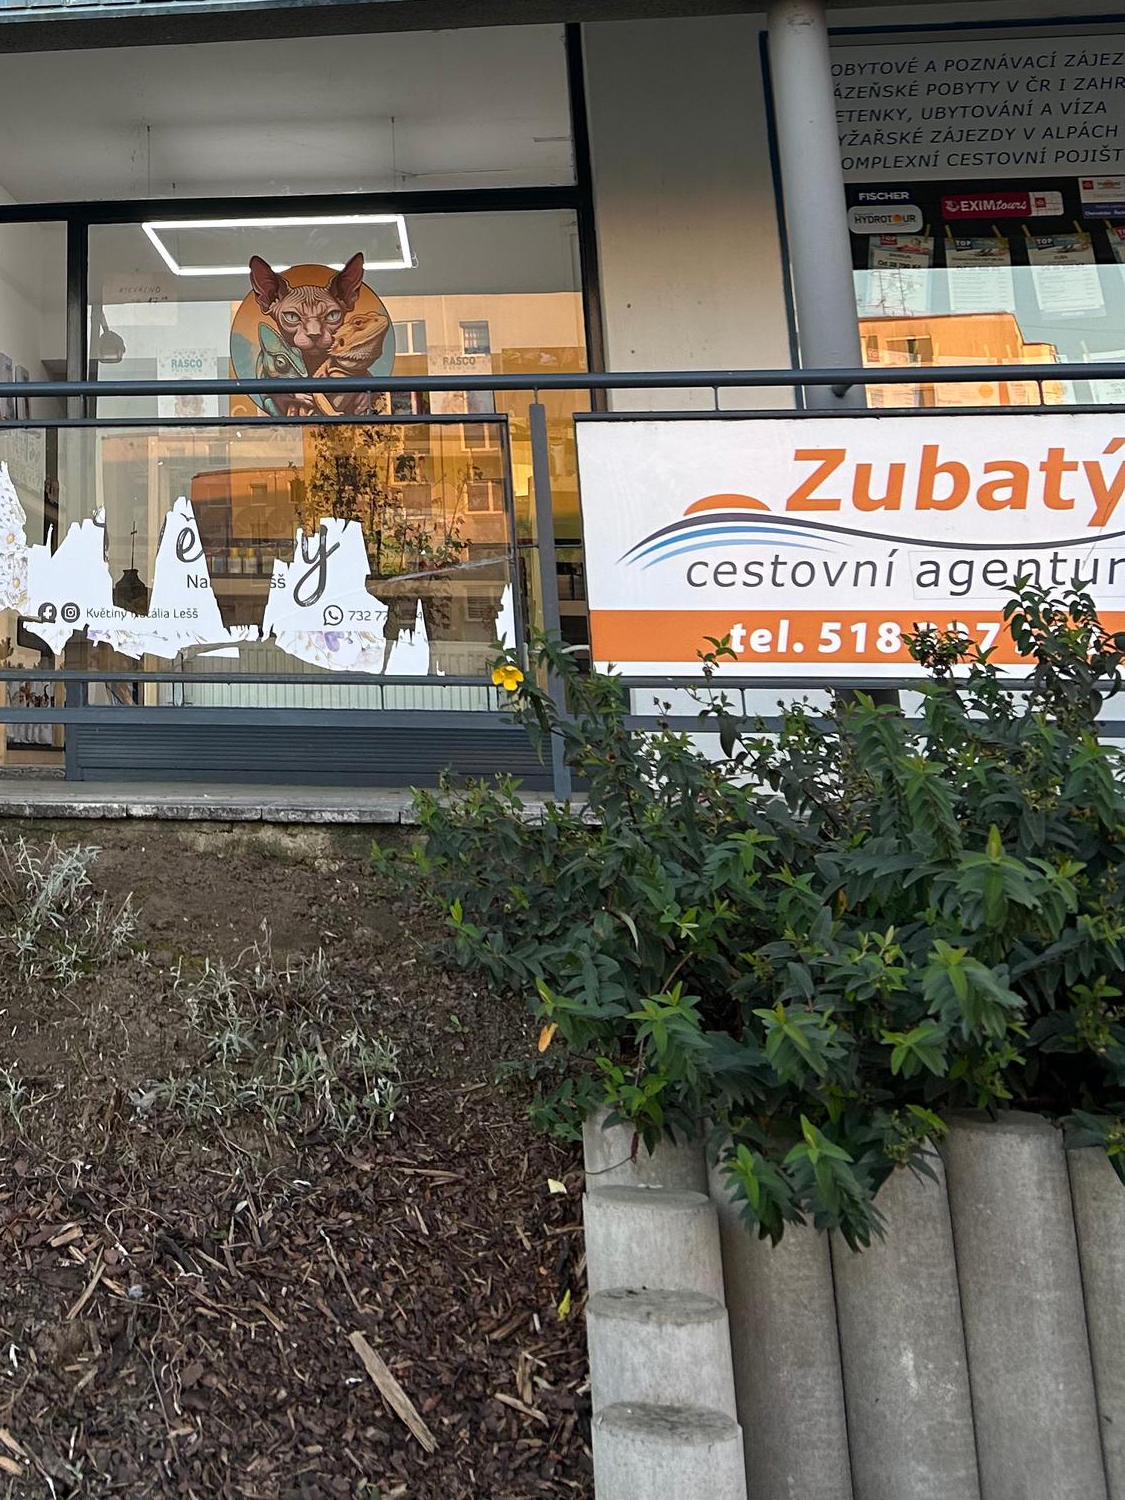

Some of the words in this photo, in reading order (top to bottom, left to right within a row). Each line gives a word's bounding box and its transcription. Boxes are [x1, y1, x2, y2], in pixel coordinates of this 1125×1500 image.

[830, 57, 919, 77] OBYTOVÉ
[924, 60, 937, 74] A
[943, 51, 1058, 72] POZNÁVACÍ
[1064, 49, 1125, 68] ZÁJEZ
[833, 80, 919, 100] ÁZEŇSKÉ
[926, 80, 1000, 97] POBYTY
[1007, 79, 1019, 93] V
[1026, 75, 1051, 93] ČR
[1058, 78, 1066, 92] I
[1073, 75, 1125, 91] ZAHR
[835, 107, 913, 124] ETENKY,
[921, 100, 1035, 120] UBYTOVÁNÍ
[1041, 102, 1052, 116] A
[1060, 98, 1107, 116] VÍZA
[837, 127, 923, 147] YŽAŘSKÉ
[930, 123, 1017, 144] ZÁJEZDY
[1024, 126, 1036, 140] V
[1042, 121, 1119, 140] ALPÁCH
[840, 150, 940, 170] OMPLEXNÍ
[946, 146, 1047, 167] CESTOVNÍ
[1054, 145, 1125, 163] POJIŠT
[858, 191, 909, 201] FISCHER
[171, 359, 202, 368] RASCO
[442, 356, 476, 366] RASCO
[785, 437, 1125, 528] Zubatý
[686, 548, 899, 589] cestovní
[915, 552, 1125, 596] agentur
[86, 607, 127, 620] Květiny
[173, 607, 199, 619] Lešš
[348, 610, 372, 621] 732
[728, 619, 804, 654] tel.
[817, 621, 902, 654] 518
